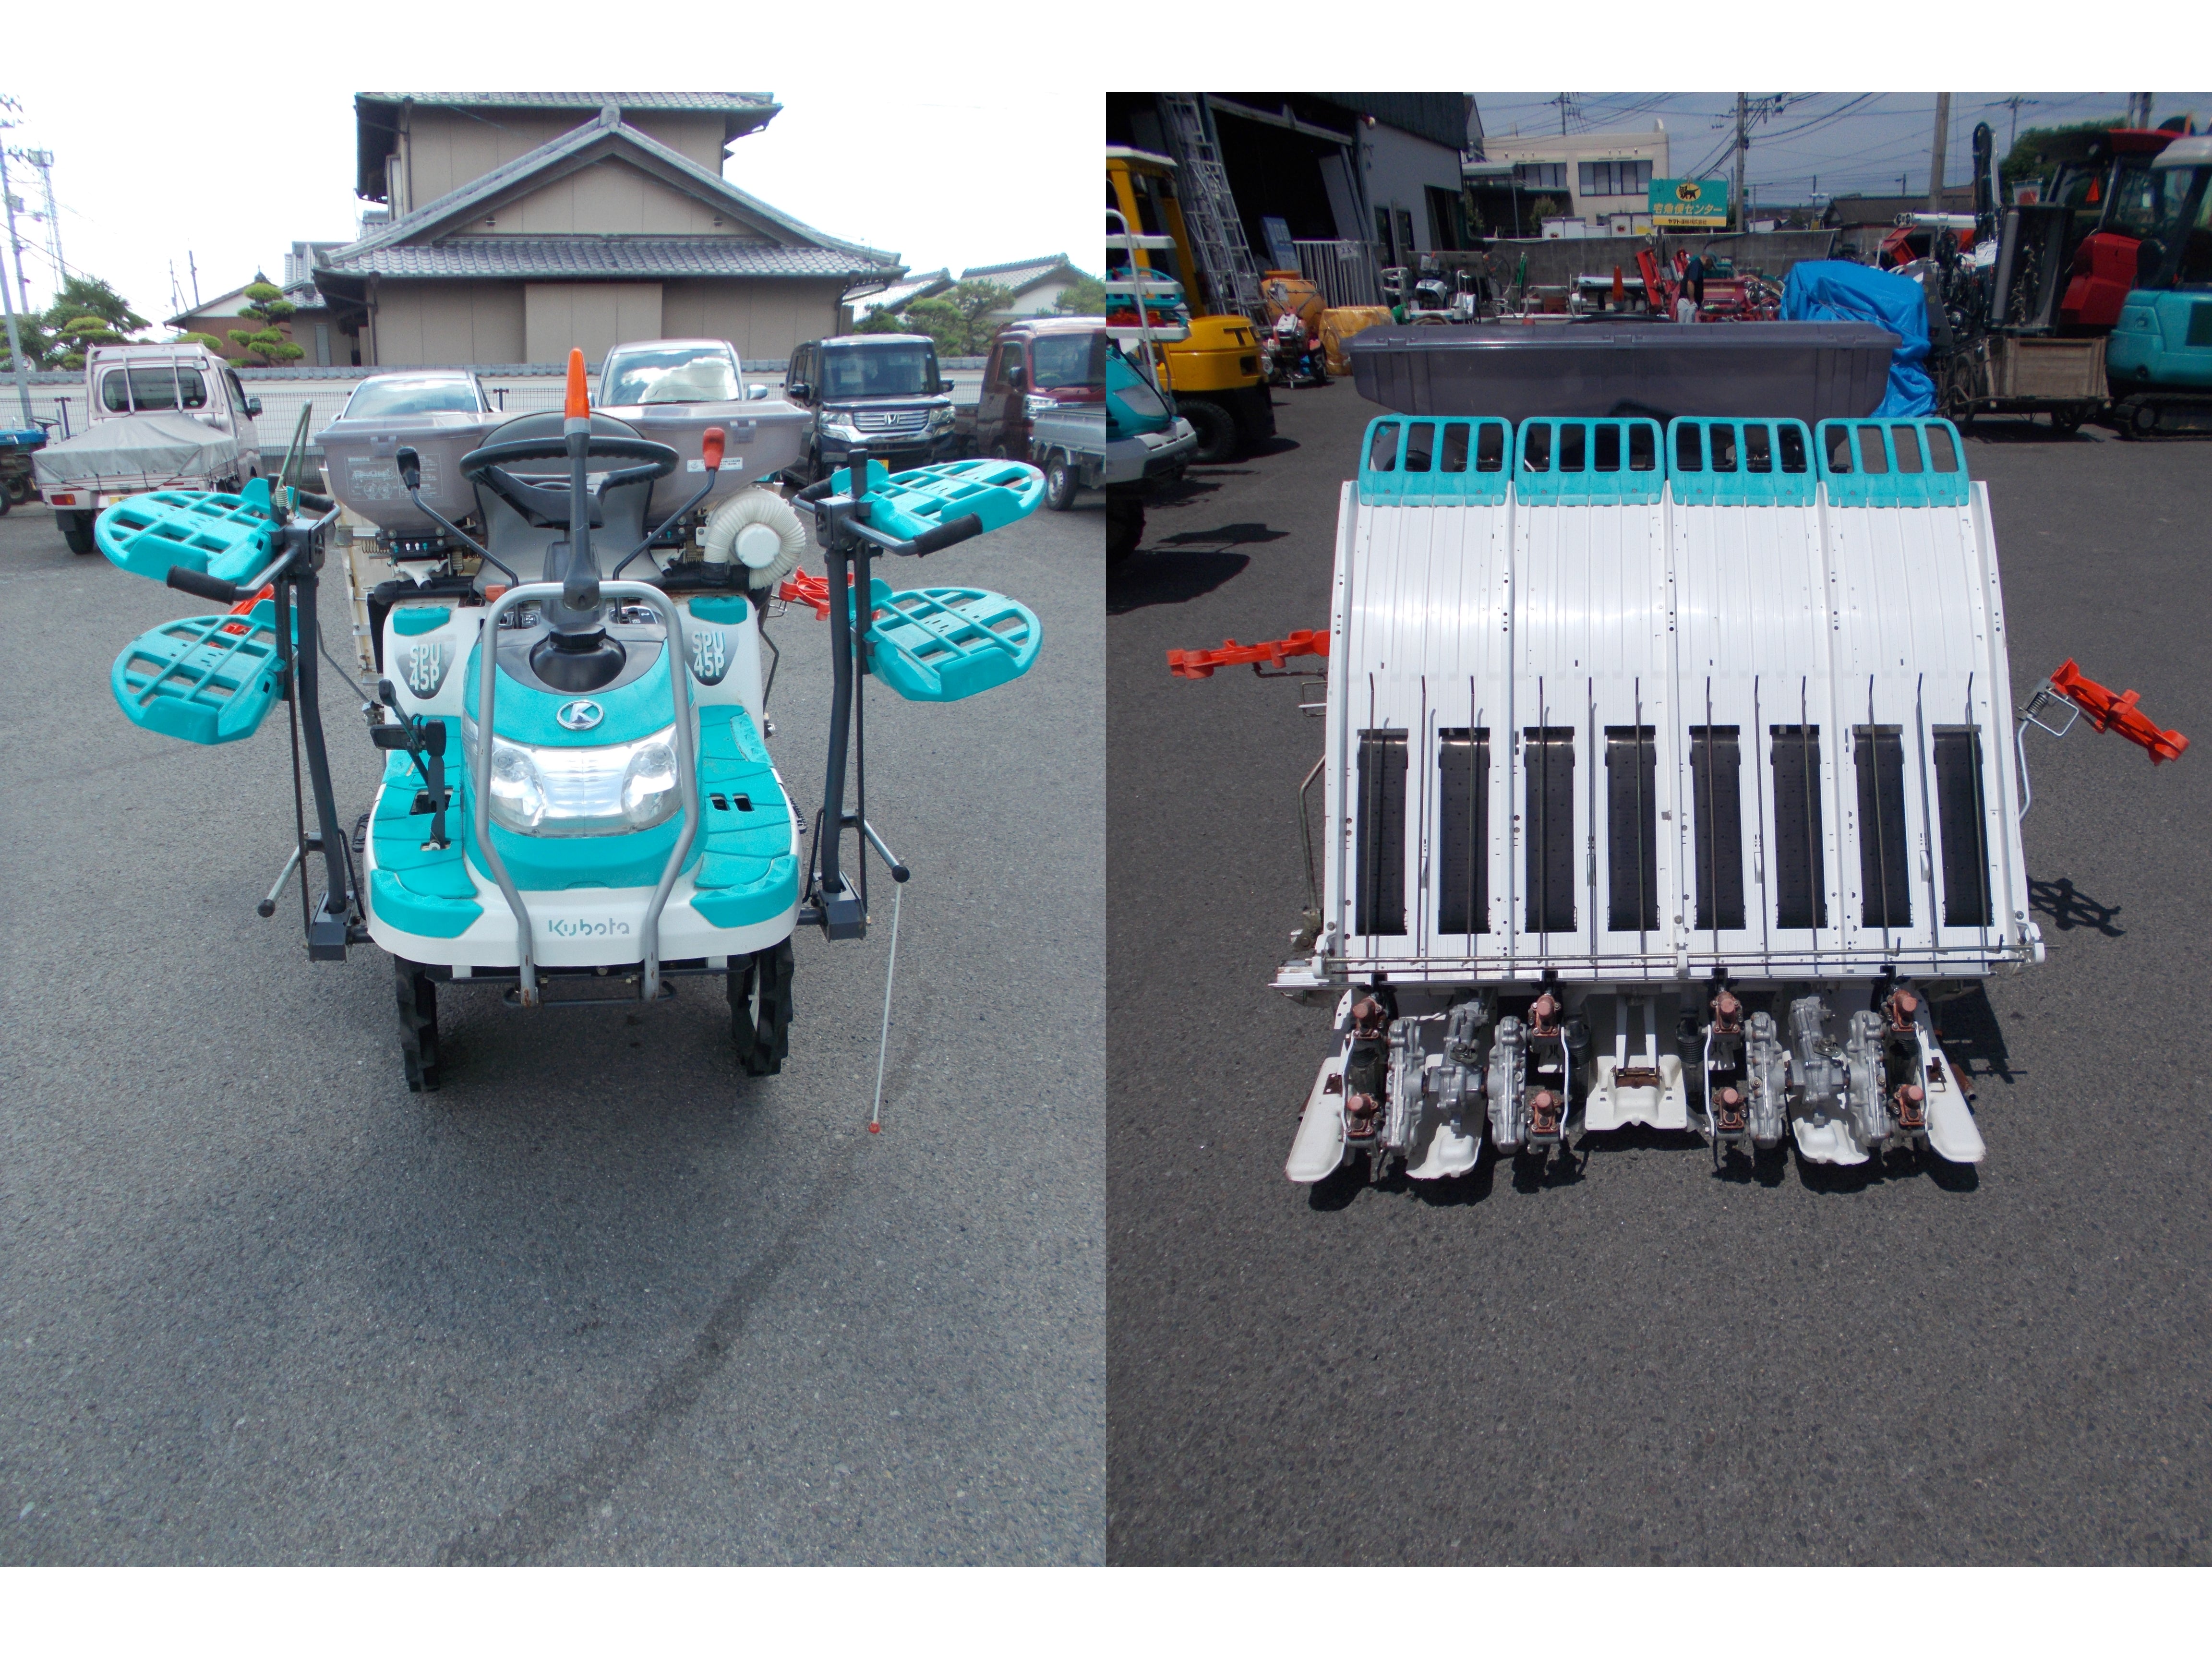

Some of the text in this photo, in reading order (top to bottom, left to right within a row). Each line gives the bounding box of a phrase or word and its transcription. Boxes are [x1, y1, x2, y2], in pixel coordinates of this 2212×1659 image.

[692, 630, 724, 653] SPU
[409, 643, 440, 668] SPU
[694, 652, 724, 676] 45P
[409, 665, 440, 690] 45P
[549, 918, 630, 937] Kubota
